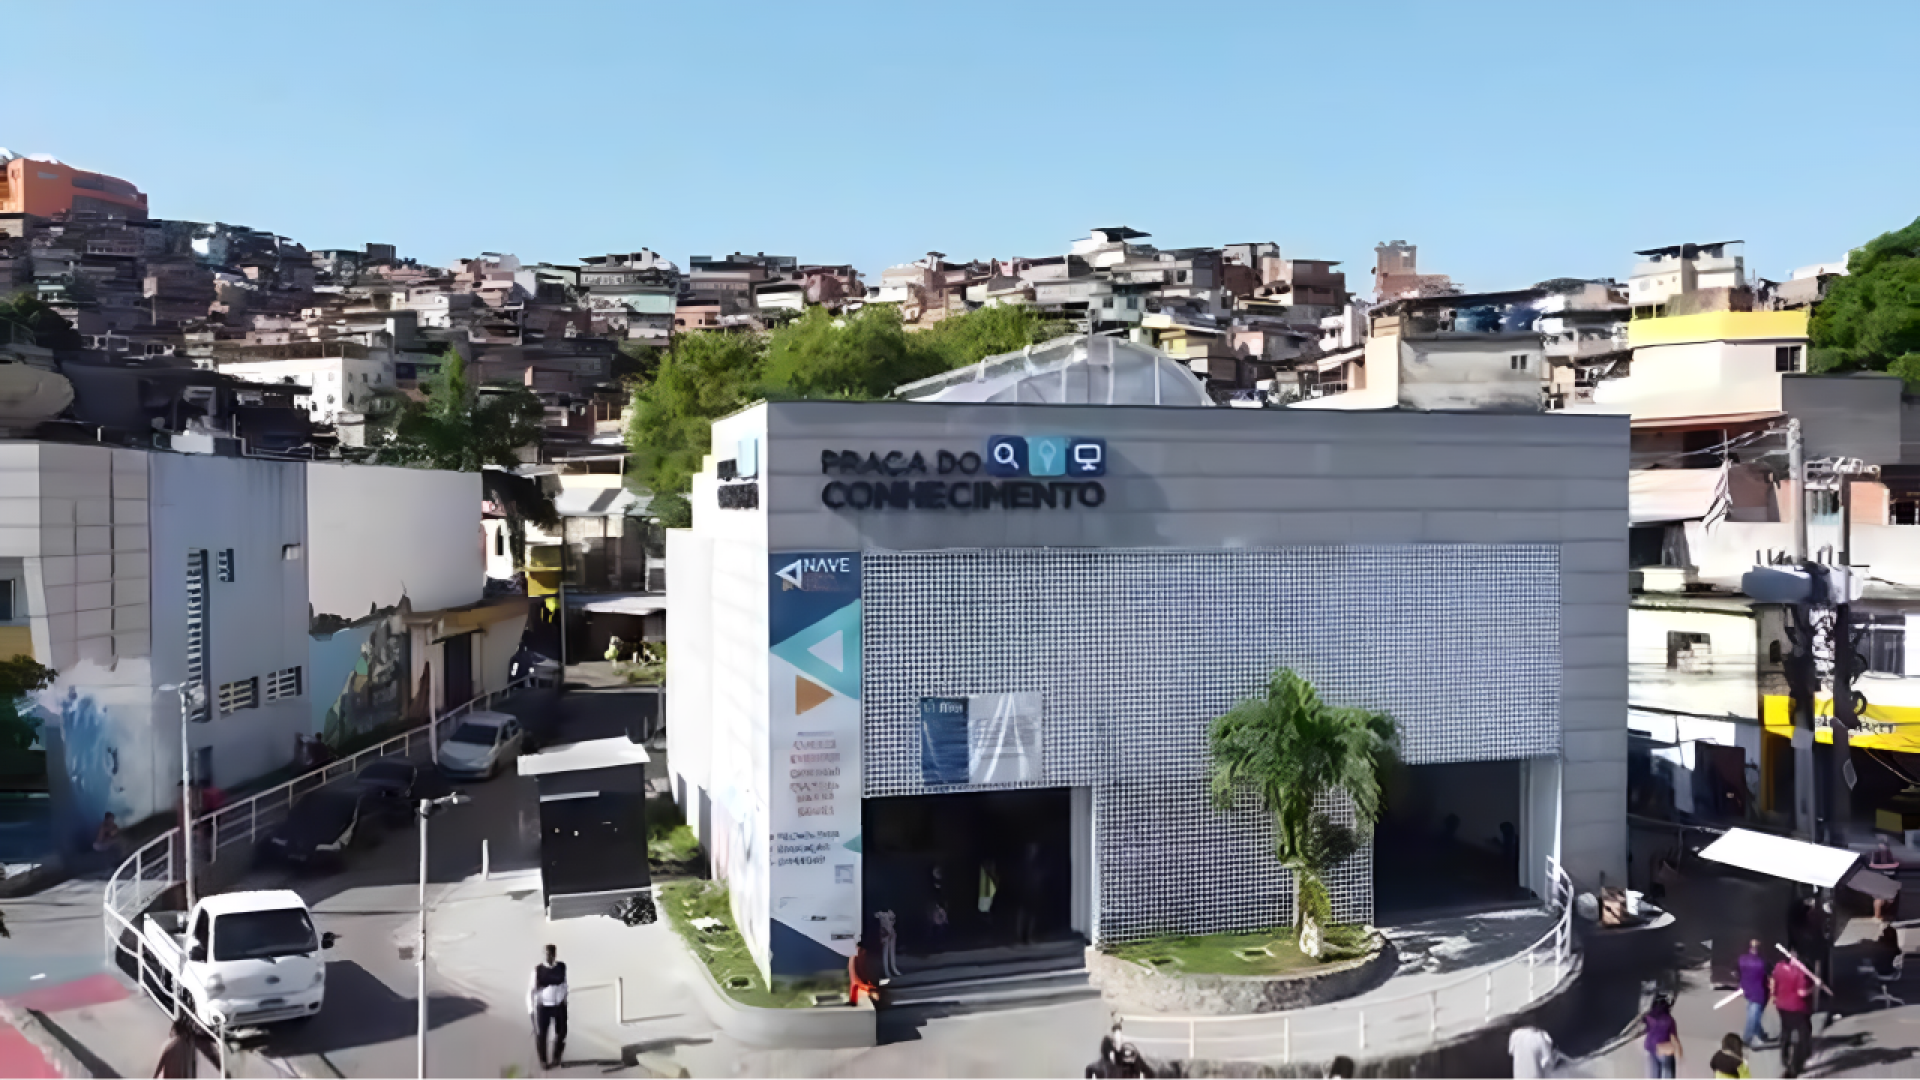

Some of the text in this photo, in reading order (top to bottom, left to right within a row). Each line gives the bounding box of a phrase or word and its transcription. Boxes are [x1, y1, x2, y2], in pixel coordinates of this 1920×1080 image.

[937, 449, 982, 475] DO
[821, 480, 1106, 510] CONHECIMENTO
[803, 557, 850, 573] NAVE
